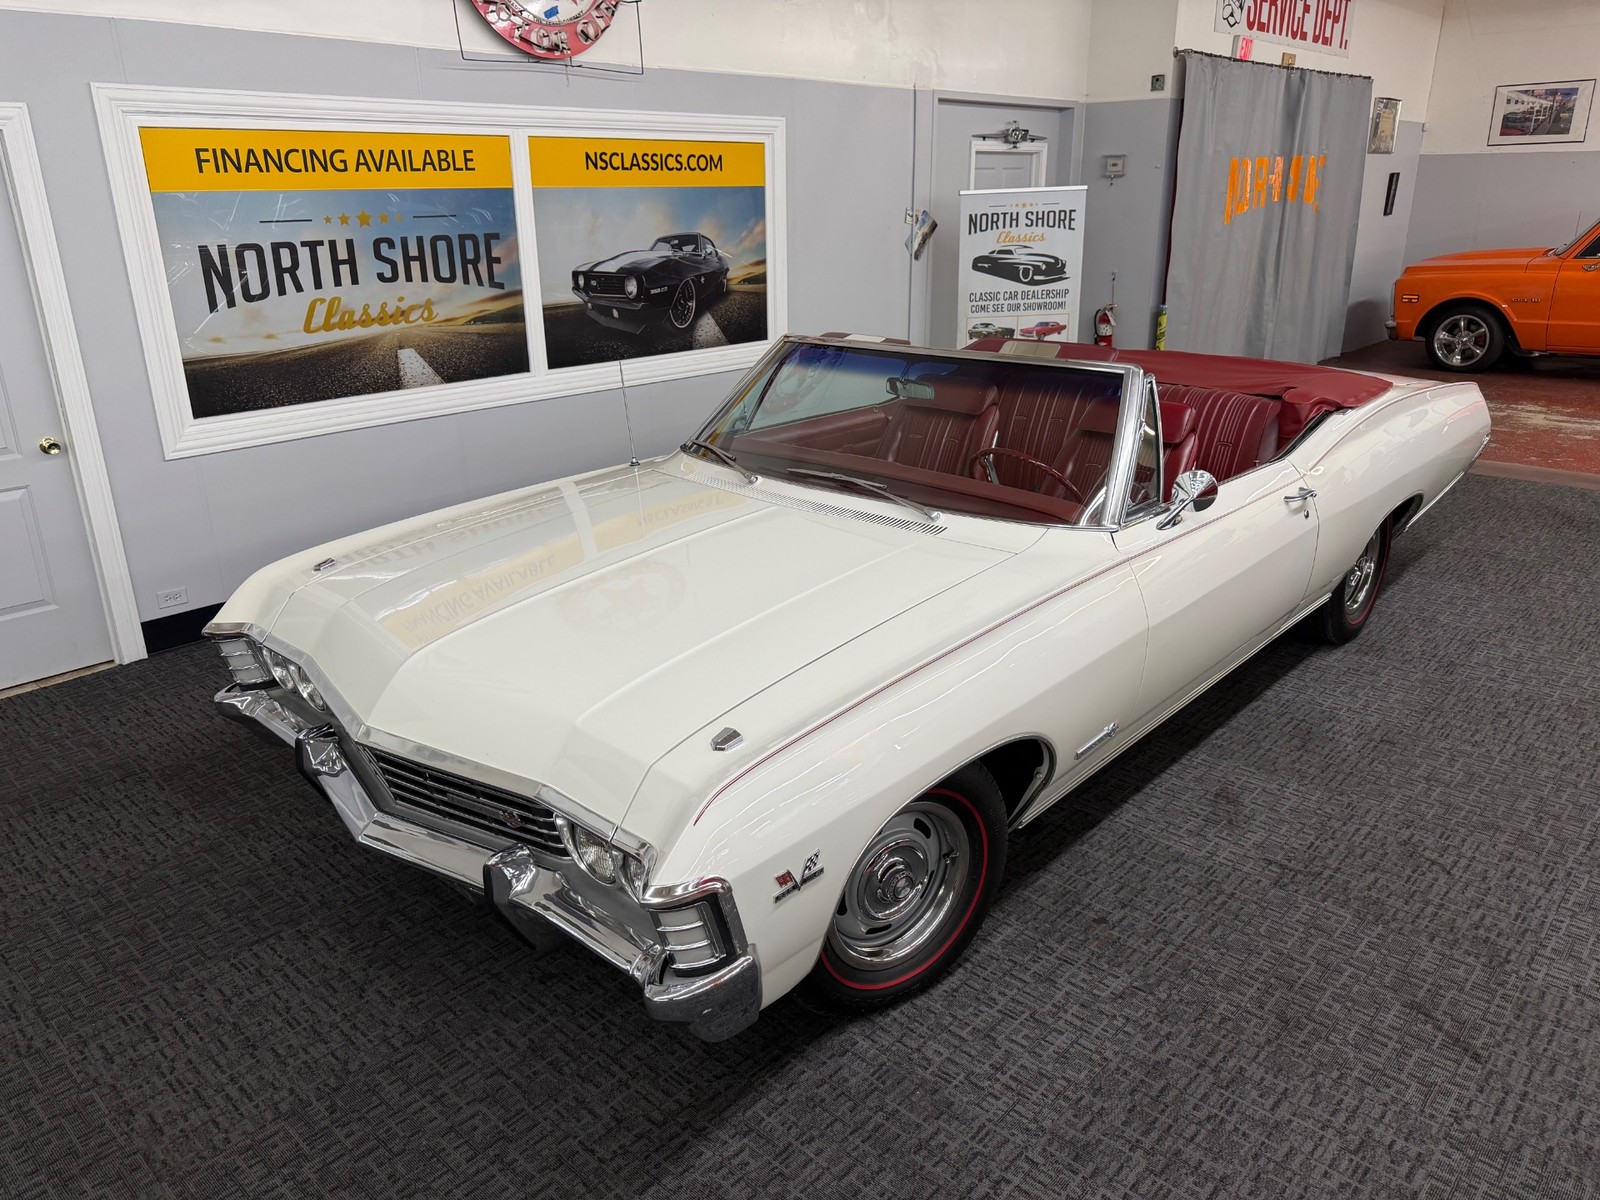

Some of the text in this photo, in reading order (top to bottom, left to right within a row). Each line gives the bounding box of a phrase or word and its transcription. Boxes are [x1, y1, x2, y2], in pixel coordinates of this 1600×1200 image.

[1246, 0, 1351, 49] SERVICE DEPT.
[195, 147, 476, 173] FINANCING AVAILABLE
[585, 151, 723, 171] NSCLASSICS.COM
[968, 209, 1077, 236] NORTH SHORE
[996, 231, 1047, 244] Classics
[198, 232, 505, 314] NORTH SHORE
[969, 288, 1069, 303] CLASSIC CAR DEALERSHIP
[970, 301, 1067, 314] COME SEE OUR SHOWROOM!
[303, 296, 439, 334] Classics
